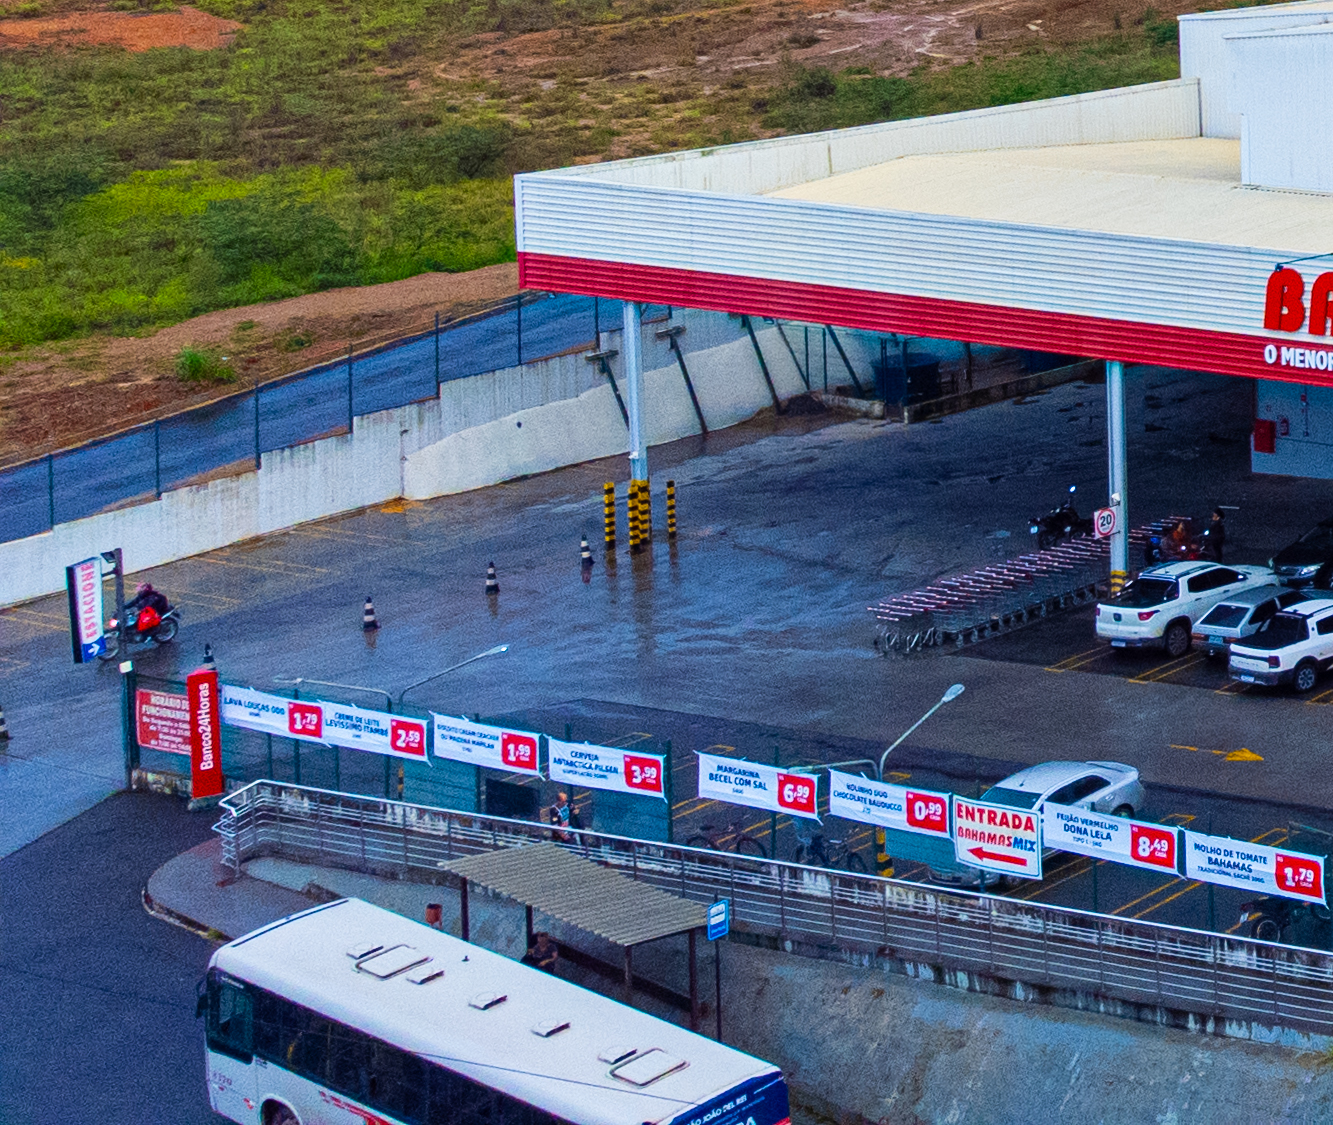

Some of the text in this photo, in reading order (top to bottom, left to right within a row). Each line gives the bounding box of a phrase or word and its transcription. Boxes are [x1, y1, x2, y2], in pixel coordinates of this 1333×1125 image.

[1264, 344, 1278, 365] O
[1100, 514, 1112, 527] 20
[224, 697, 243, 707] LAVA
[244, 700, 270, 713] LOUÇAS
[196, 682, 214, 771] Banco24Horas
[294, 712, 318, 730] 1,79
[364, 718, 380, 727] LEITE
[396, 728, 420, 748] 2,59
[507, 743, 531, 762] 1,99
[570, 750, 600, 762] CERVEJA
[553, 757, 593, 771] ANTARCTICA
[594, 764, 619, 775] PILSEN
[631, 765, 657, 784] 3,99
[716, 764, 761, 779] MARGARINA
[708, 772, 768, 791] BECEL COM SAL
[783, 783, 810, 803] 6,99
[914, 800, 943, 821] 0,99
[956, 802, 1036, 833] ENTRADA
[1056, 812, 1119, 832] FEIJÃO VERMELHO
[1063, 823, 1089, 837] DONA
[1137, 836, 1169, 858] 8,49
[1194, 842, 1268, 865] MOLHO DE TOMATE
[1207, 856, 1253, 873] BAHAMAS
[1284, 866, 1315, 887] 1,79
